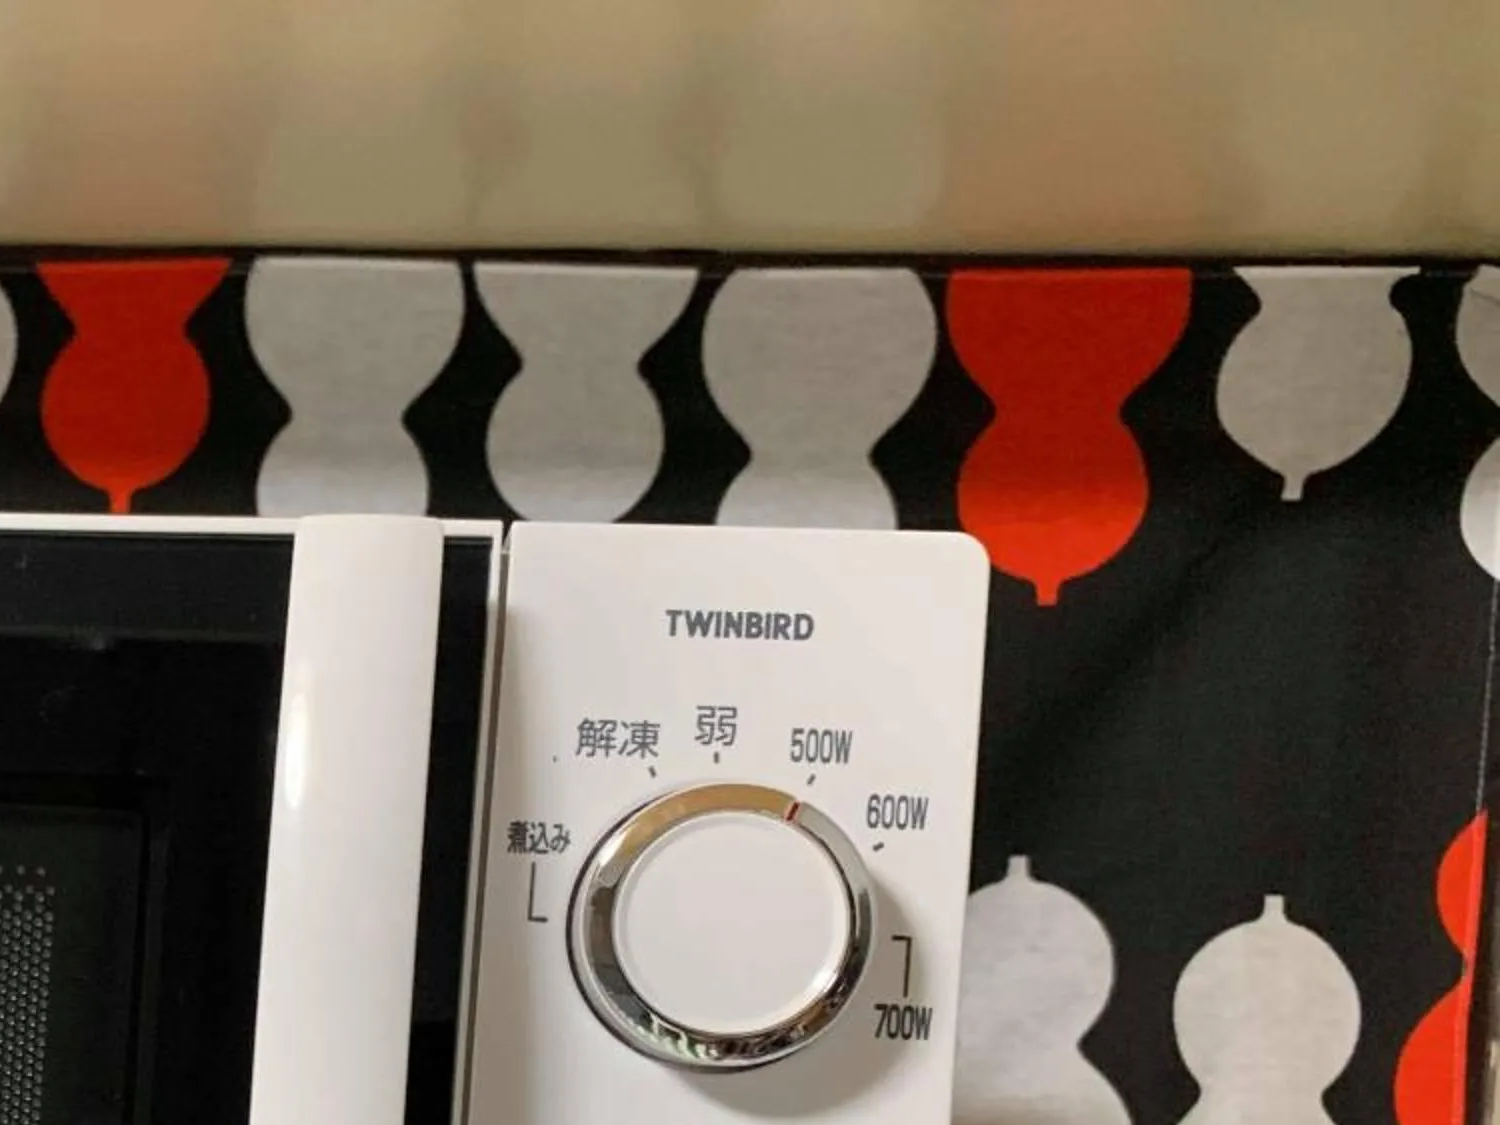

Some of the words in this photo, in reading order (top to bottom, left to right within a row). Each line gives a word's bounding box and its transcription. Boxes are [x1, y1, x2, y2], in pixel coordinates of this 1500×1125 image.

[666, 610, 814, 641] TWINBIRD
[575, 717, 661, 759] 解凍
[694, 705, 739, 748] 弱
[790, 728, 853, 764] 500W
[866, 794, 929, 830] 600W
[507, 821, 571, 855] 煮込み
[873, 1004, 933, 1041] 700W
